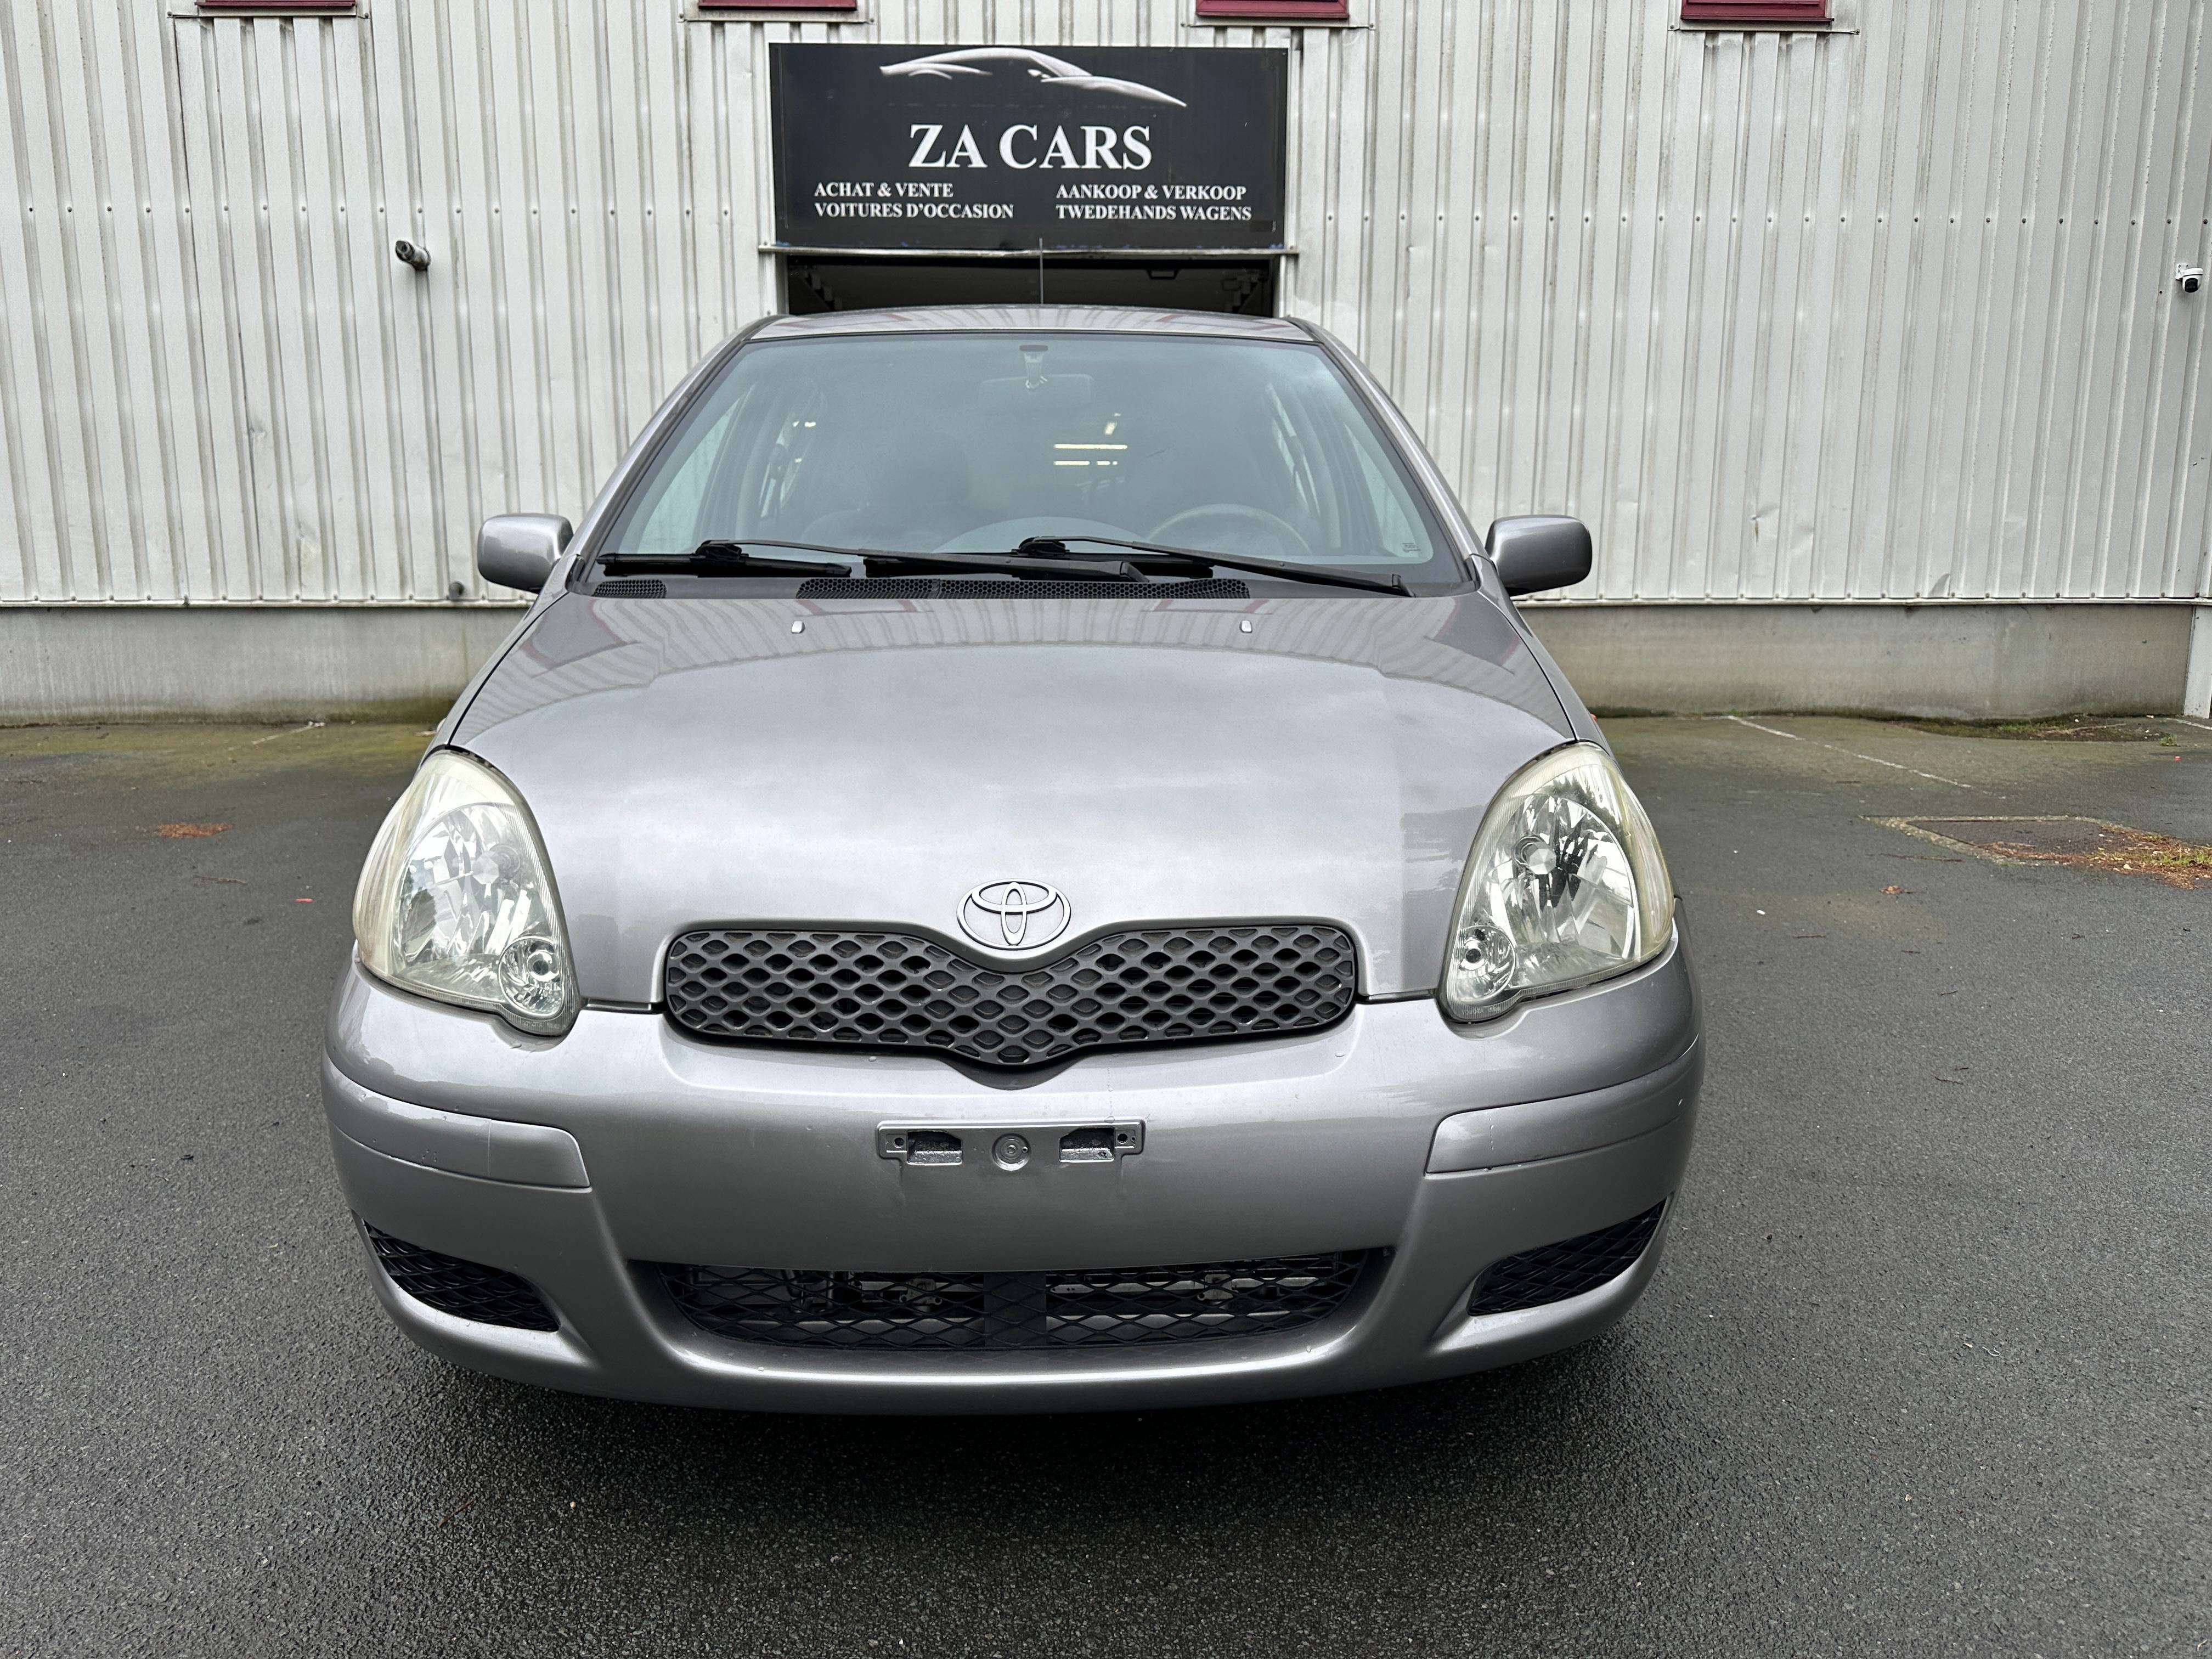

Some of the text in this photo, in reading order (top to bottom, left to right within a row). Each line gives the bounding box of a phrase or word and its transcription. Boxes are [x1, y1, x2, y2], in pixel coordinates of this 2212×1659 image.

[908, 124, 1152, 170] ZA CARS
[814, 182, 953, 198] ACHAT & VENTE
[1056, 184, 1246, 200] AANKOOP & VERKOOP
[814, 202, 1014, 218] VOITURES D'OCCASION
[1055, 205, 1252, 221] TWEDEHANDS WAGENS
